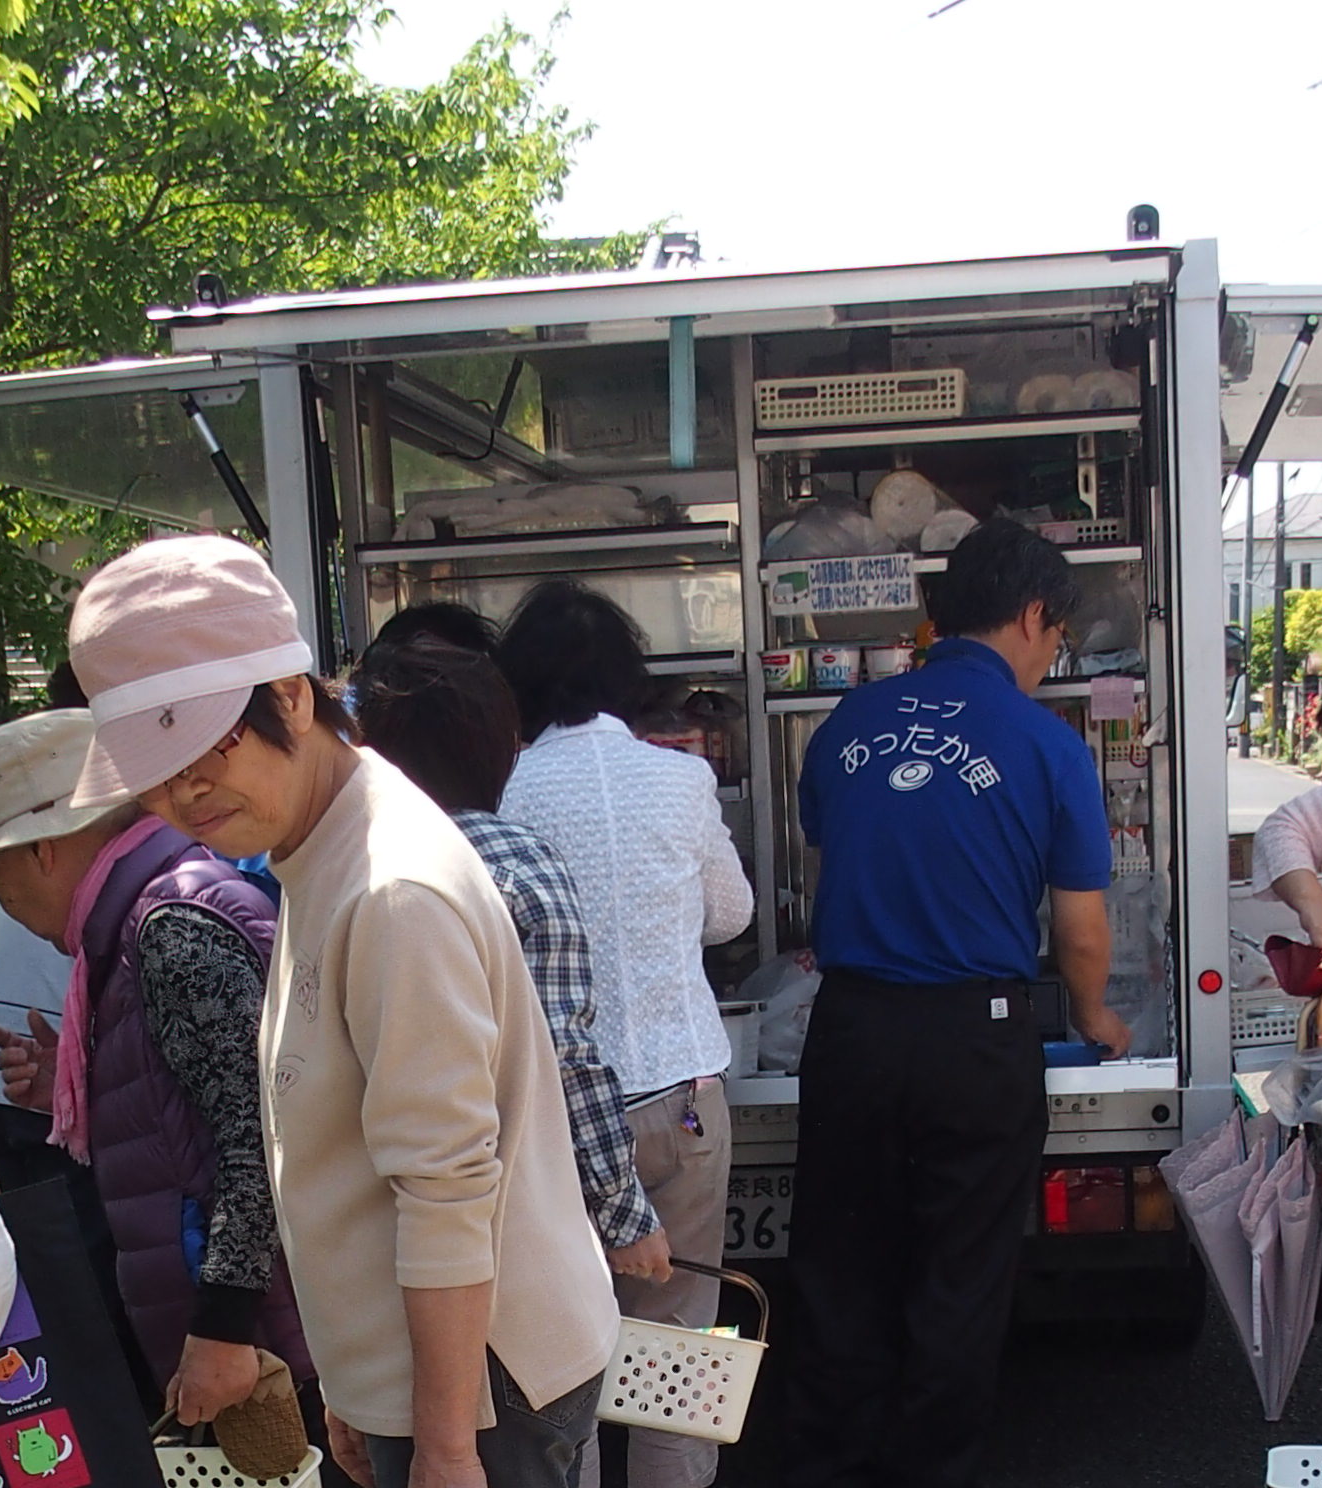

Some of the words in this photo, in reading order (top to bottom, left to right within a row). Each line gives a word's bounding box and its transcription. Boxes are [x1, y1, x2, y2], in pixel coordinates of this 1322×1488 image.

[897, 696, 967, 719] コープ
[838, 722, 1002, 796] あったか便
[725, 1206, 791, 1251] 36-
[34, 1397, 53, 1409] CAT
